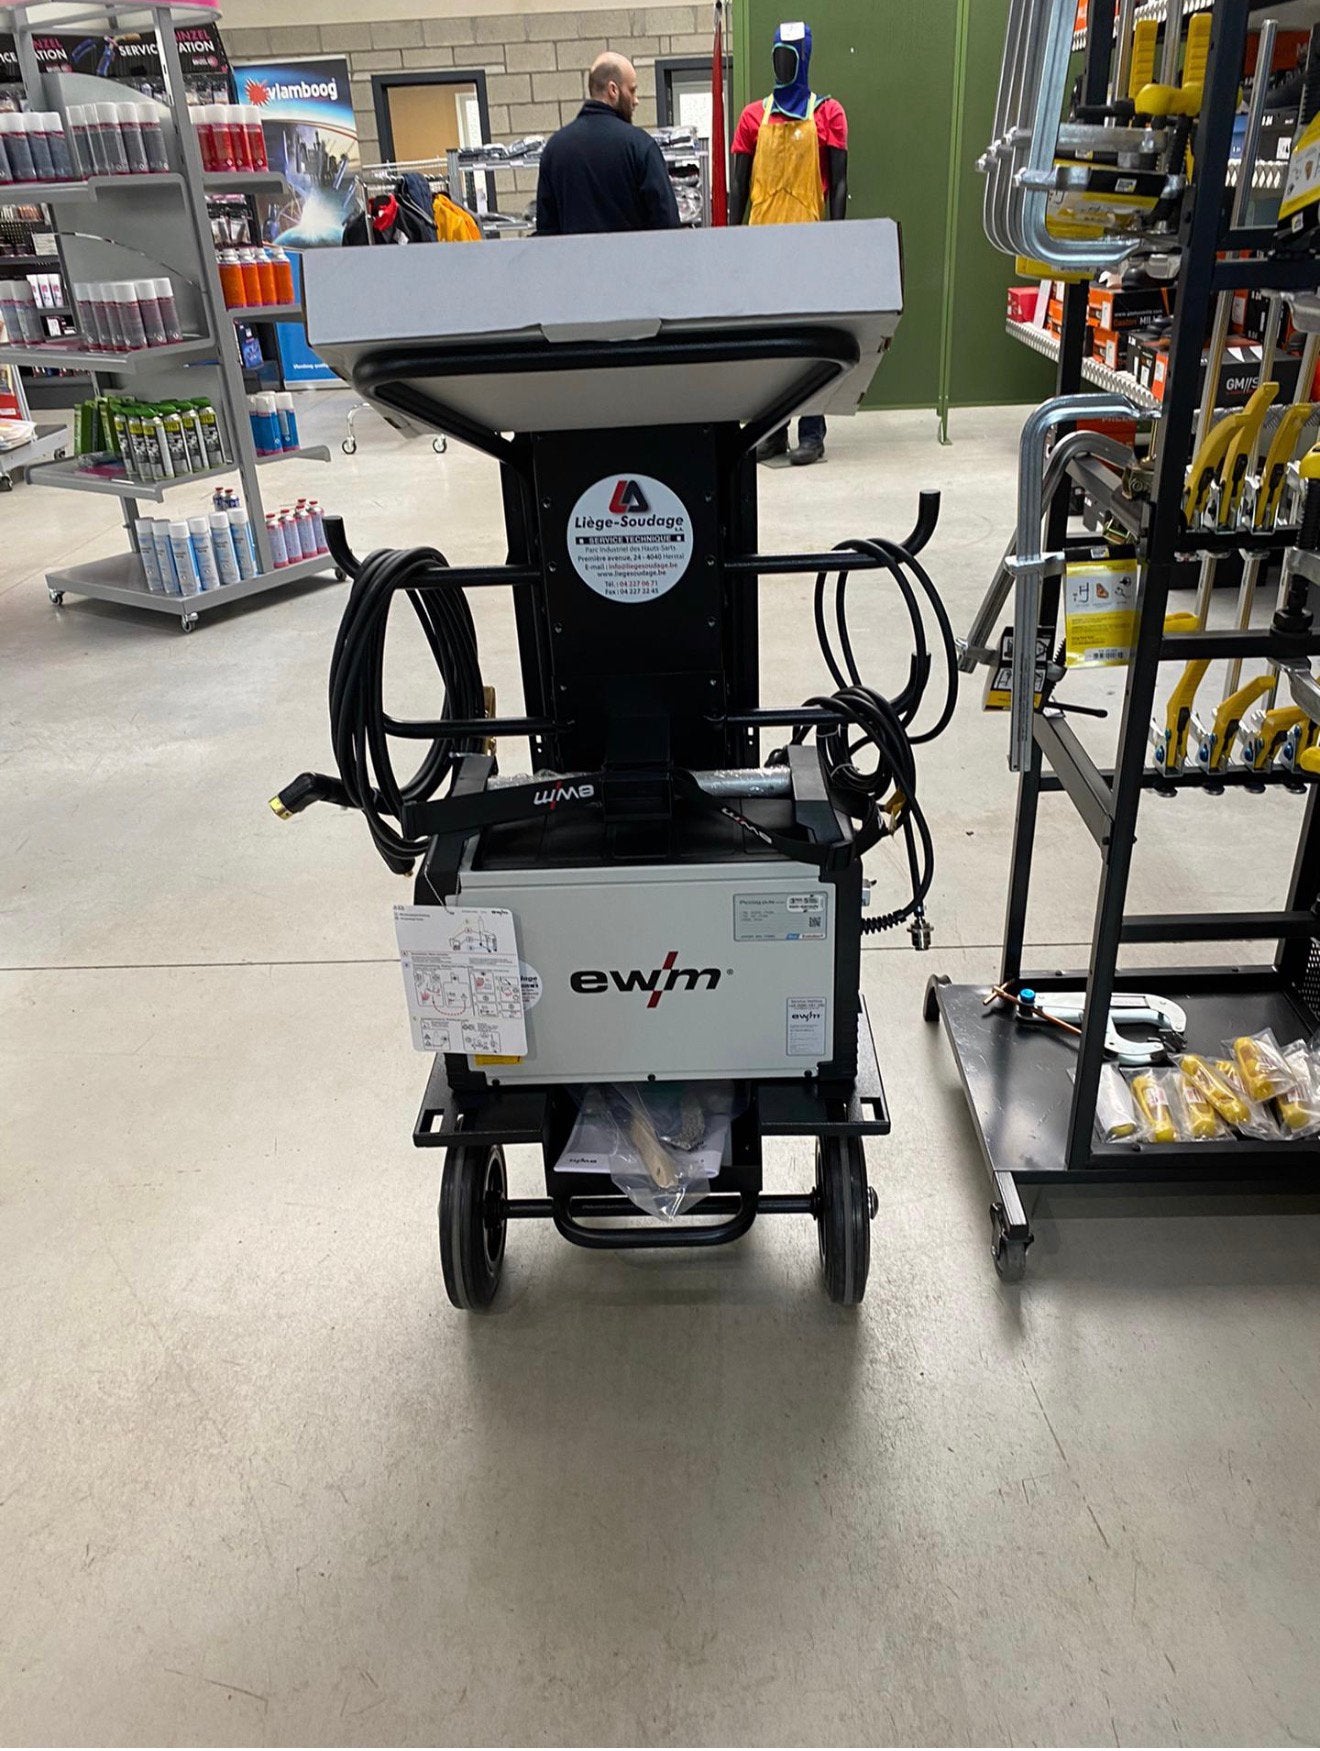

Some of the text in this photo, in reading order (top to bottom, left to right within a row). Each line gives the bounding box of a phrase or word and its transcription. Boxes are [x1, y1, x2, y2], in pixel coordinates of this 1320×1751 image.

[35, 48, 68, 61] TION
[119, 40, 215, 57] SERVIC ATION
[266, 78, 338, 101] vlamboog
[575, 514, 684, 530] Liège-Soudage
[588, 534, 672, 545] SERVICE TECHNIQUE
